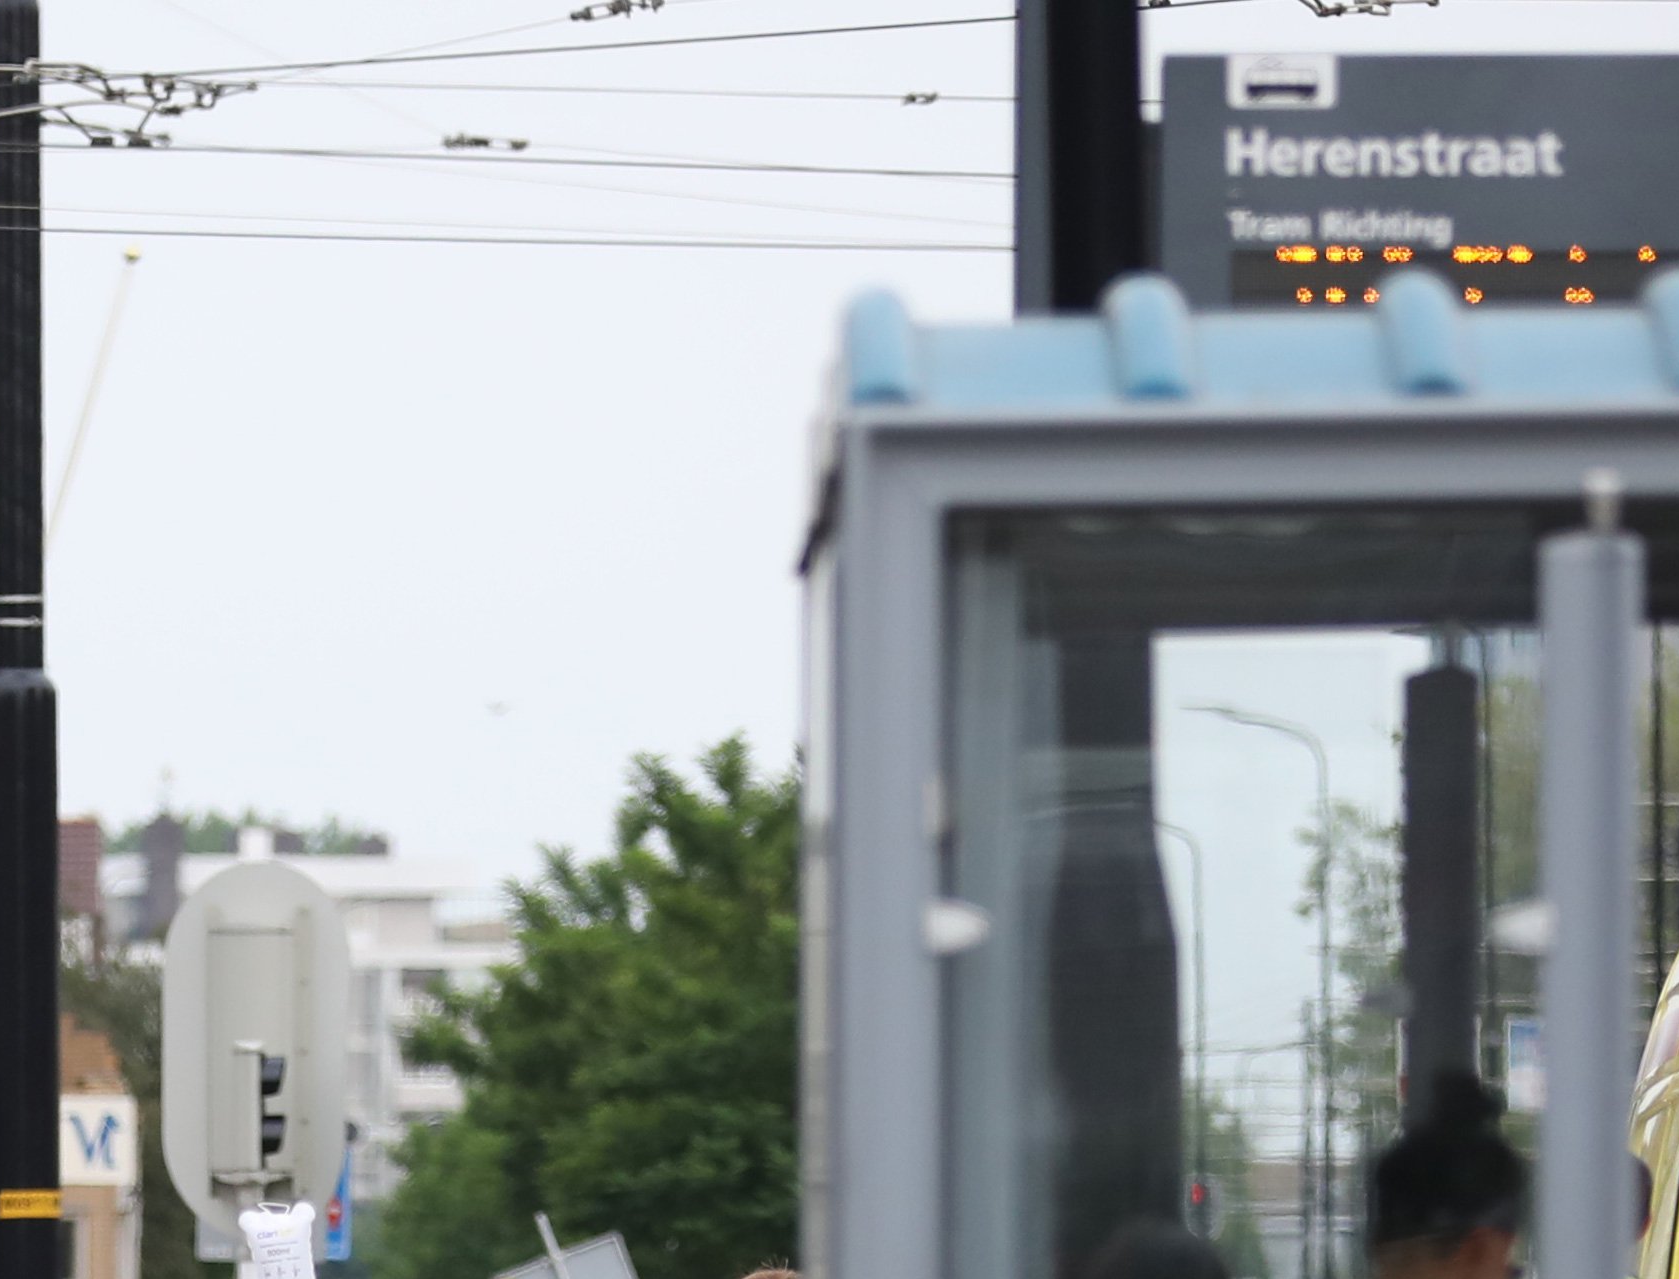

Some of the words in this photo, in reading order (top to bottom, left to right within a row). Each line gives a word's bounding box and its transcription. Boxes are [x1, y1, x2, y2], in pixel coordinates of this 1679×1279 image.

[1225, 129, 1564, 177] Herenstraat
[1227, 211, 1311, 240] Tram
[1320, 209, 1453, 245] Richting
